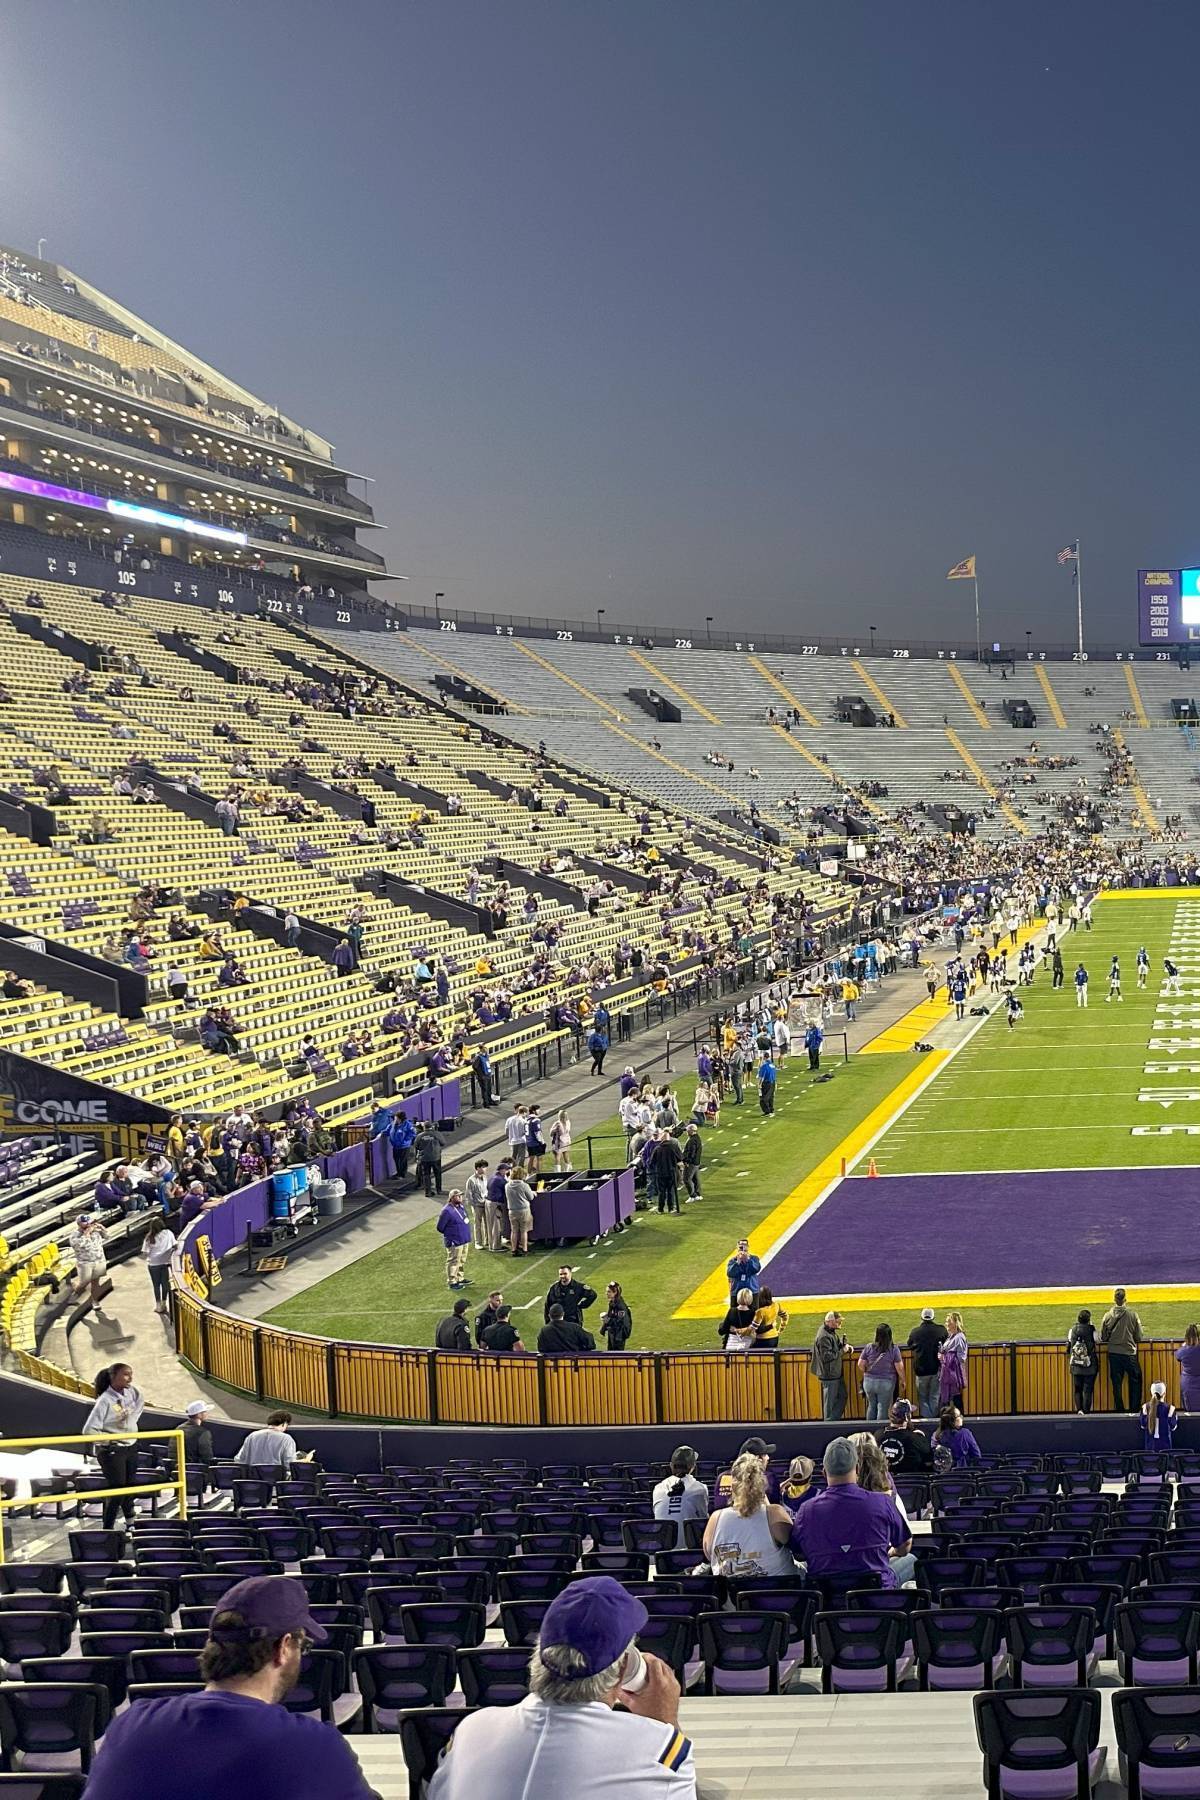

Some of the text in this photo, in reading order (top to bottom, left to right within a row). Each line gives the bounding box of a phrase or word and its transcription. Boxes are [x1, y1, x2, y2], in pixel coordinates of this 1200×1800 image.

[118, 571, 136, 586] 105
[218, 589, 234, 604] 106
[1150, 595, 1168, 605] 1958
[267, 599, 283, 613] 222
[1150, 606, 1169, 615] 2003
[336, 610, 351, 623] 223
[1150, 617, 1169, 626] 2007
[440, 620, 456, 632] 224
[556, 631, 573, 641] 225
[1151, 628, 1169, 637] 2019
[675, 639, 692, 649] 226
[802, 646, 819, 655] 227
[893, 650, 910, 658] 228
[1156, 652, 1171, 661] 231
[17, 1100, 109, 1123] COME
